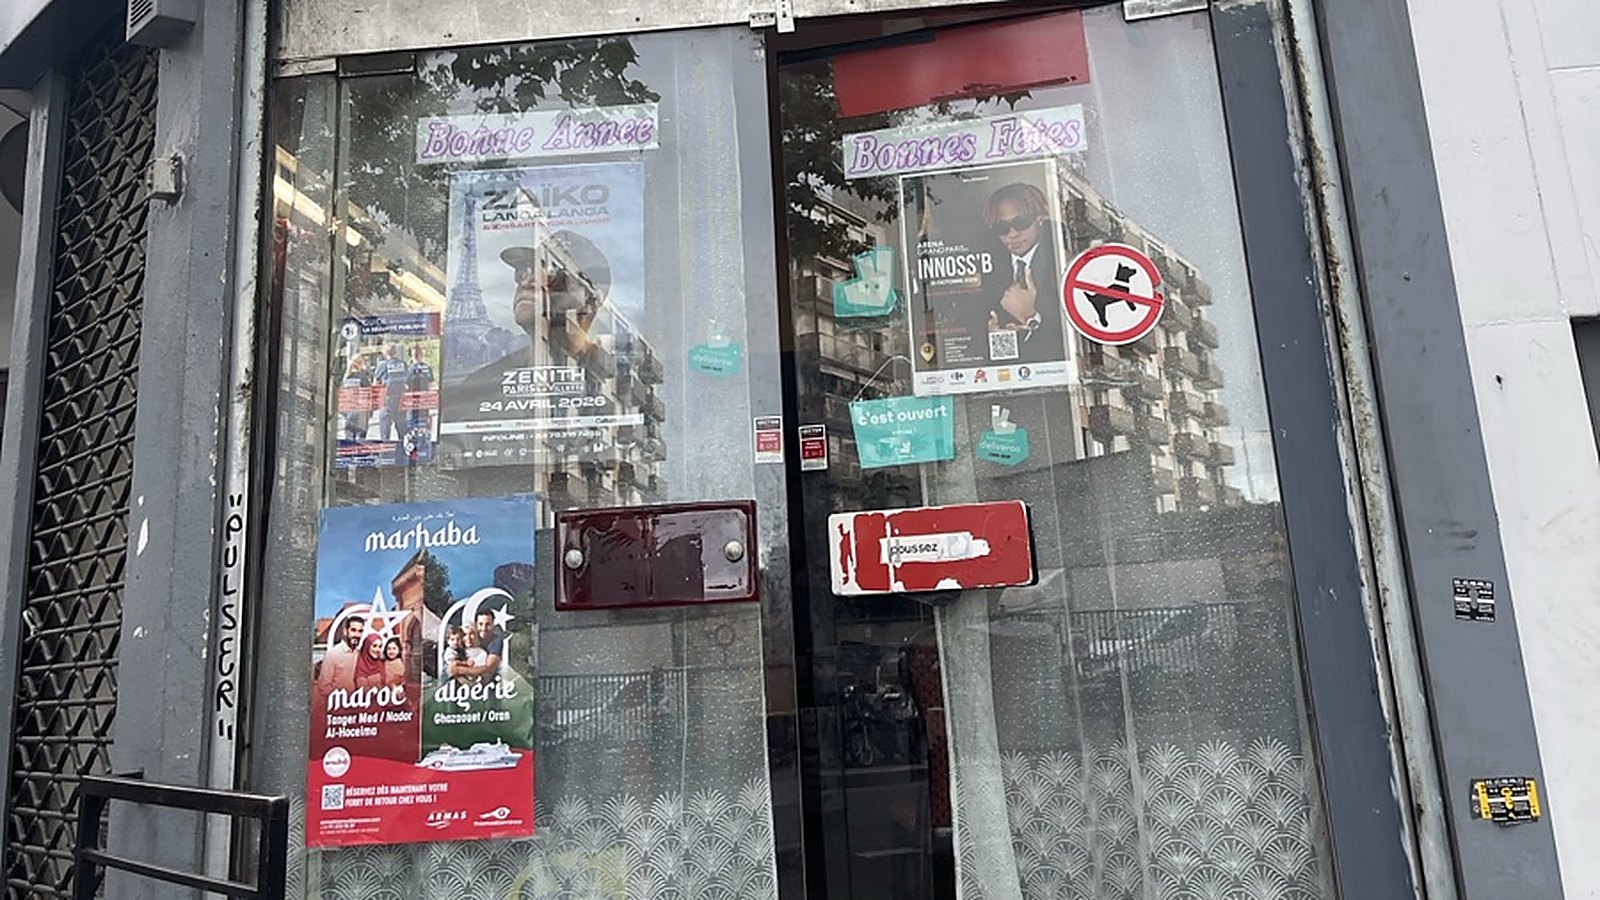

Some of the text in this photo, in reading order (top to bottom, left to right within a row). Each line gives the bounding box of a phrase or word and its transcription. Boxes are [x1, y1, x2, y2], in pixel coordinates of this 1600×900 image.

[422, 121, 534, 159] Bonne
[850, 133, 977, 175] Bonnes
[547, 206, 610, 219] LANGA
[917, 253, 993, 279] INNOSS'B
[501, 367, 585, 385] ZENITH
[479, 396, 606, 412] 24 AVRIL 2026
[858, 405, 948, 427] c'est ouvert
[364, 521, 480, 552] marhaba
[889, 542, 938, 557] poussez
[327, 684, 407, 711] maroc
[434, 675, 518, 712] algérie
[327, 711, 413, 726] Tanger Med / Nador
[482, 710, 487, 722] /
[488, 710, 511, 721] Oran
[325, 725, 377, 739] Al-Hoceima
[427, 810, 467, 821] ARMAS
